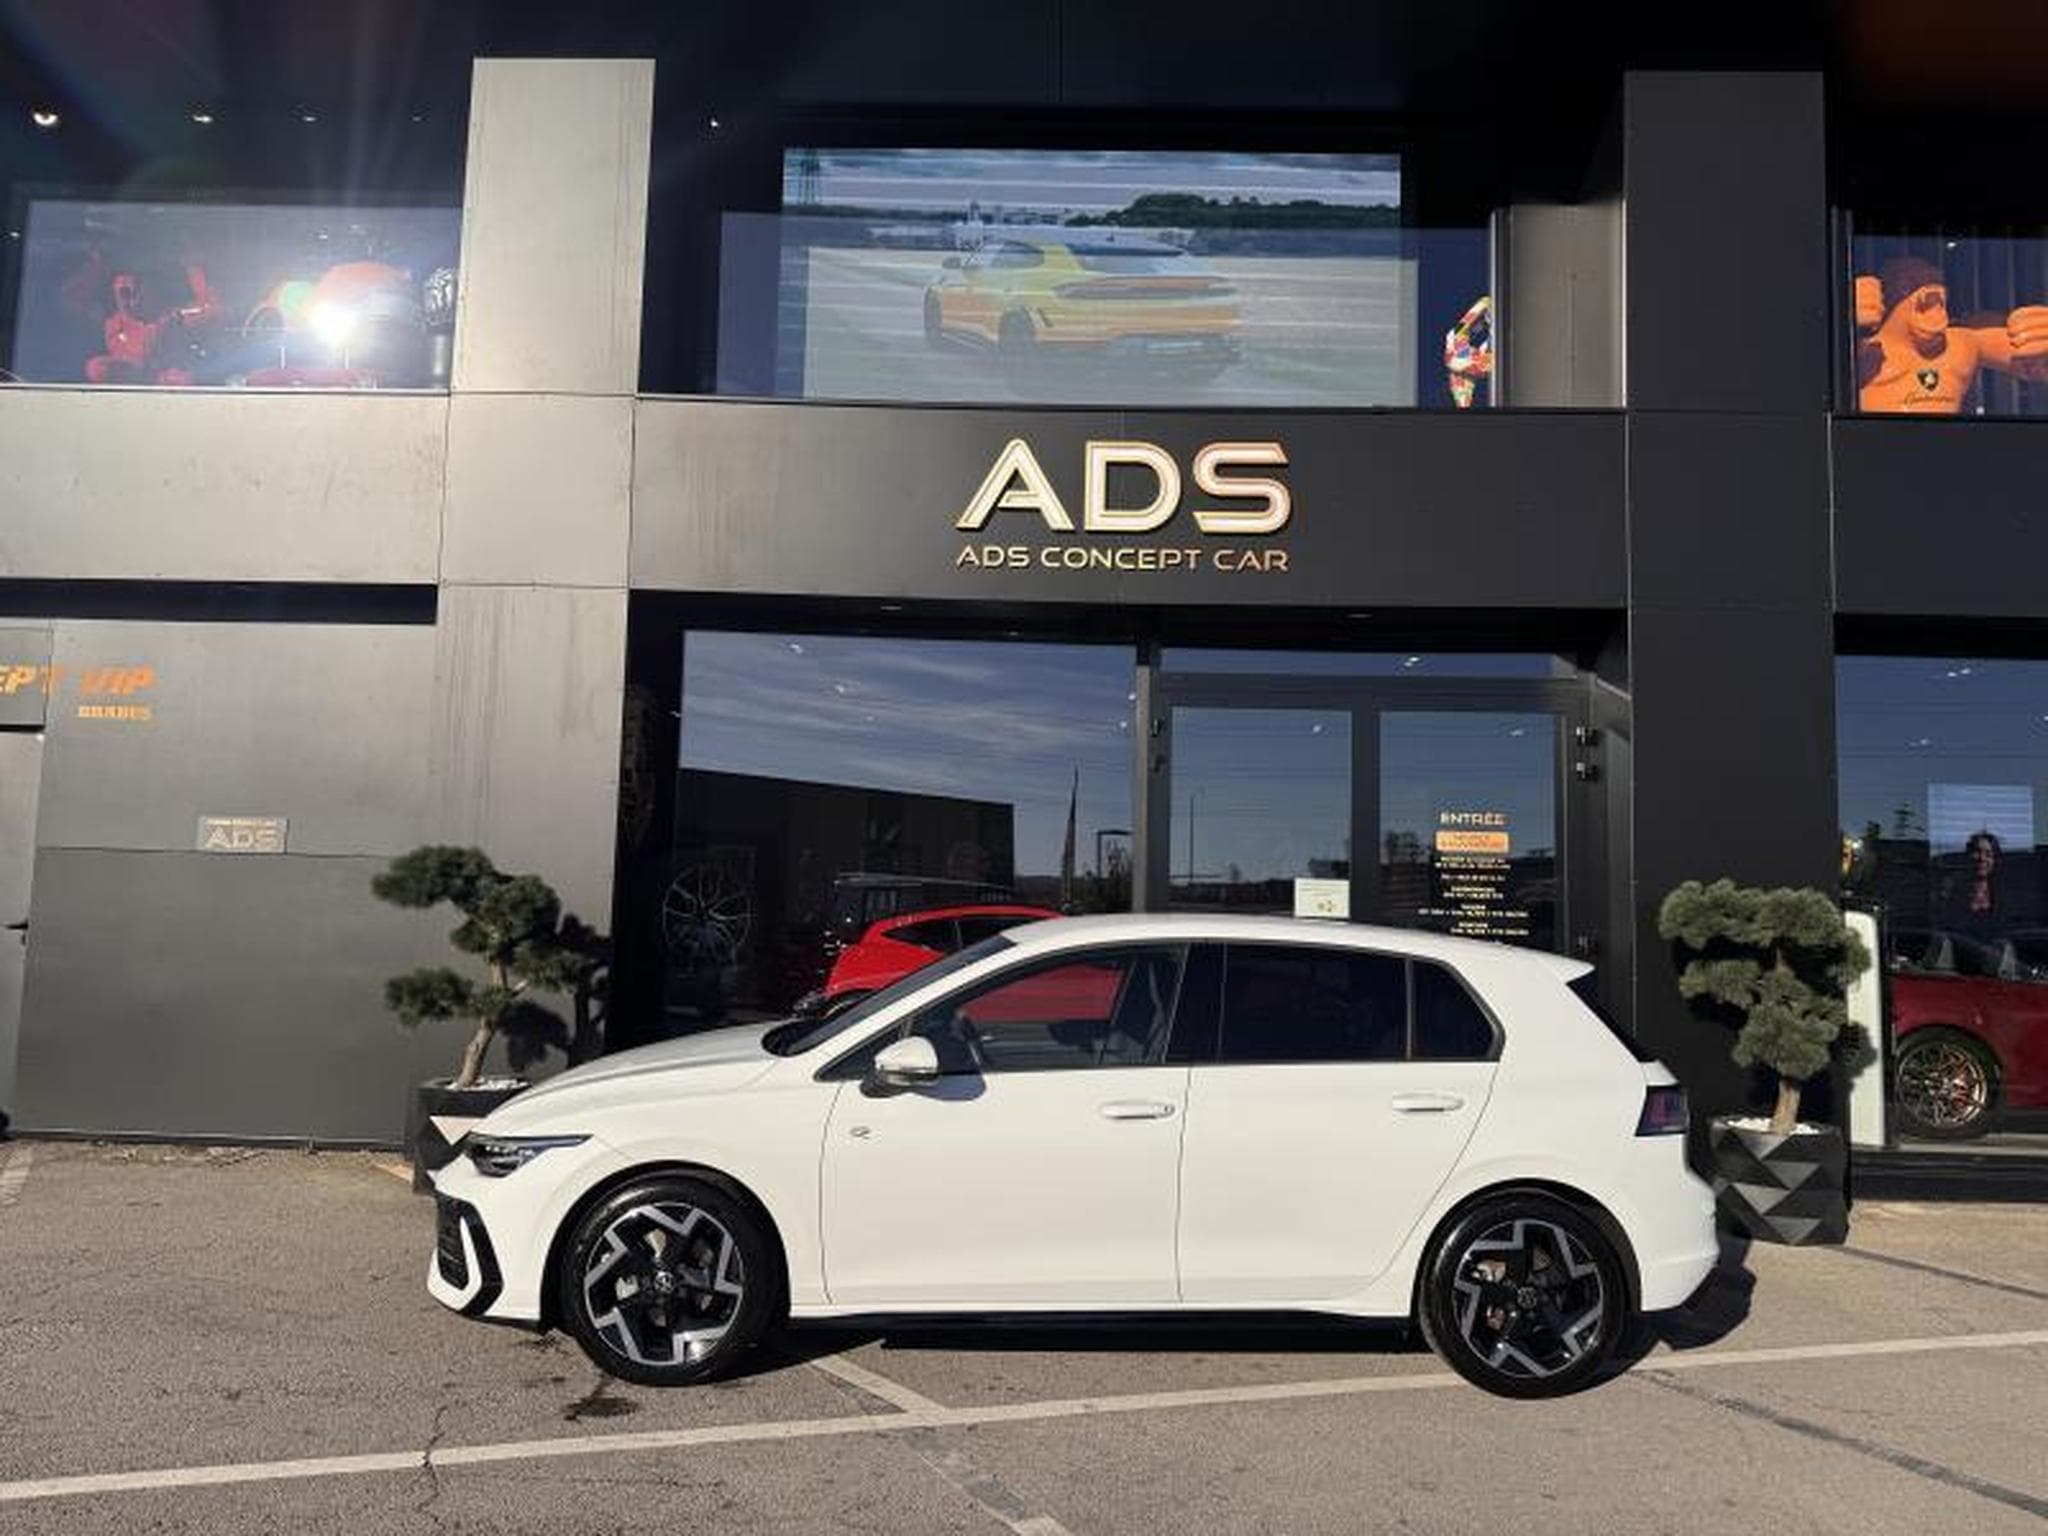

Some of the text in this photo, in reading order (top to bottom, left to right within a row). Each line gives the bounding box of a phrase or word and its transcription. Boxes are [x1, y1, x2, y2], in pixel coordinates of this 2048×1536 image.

[955, 437, 1293, 534] ADS
[956, 545, 1290, 573] ADS CONCEPT CAR
[205, 825, 283, 849] ADS
